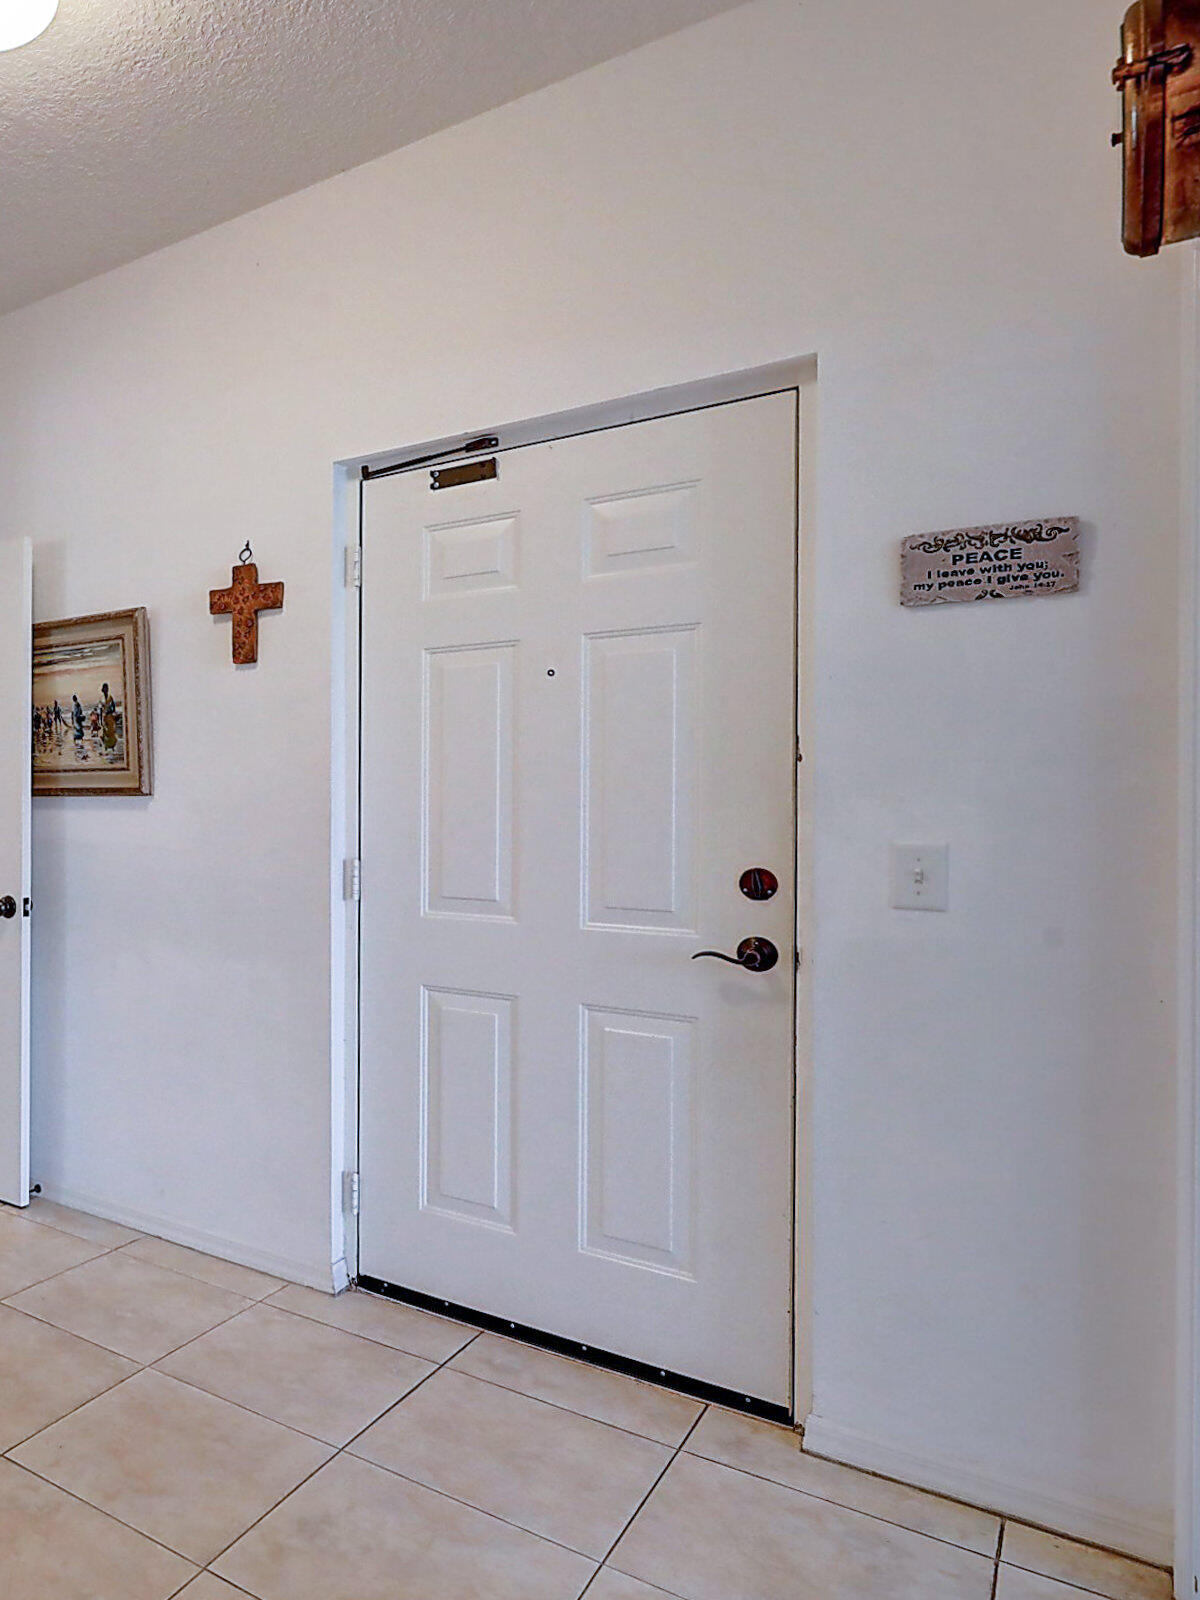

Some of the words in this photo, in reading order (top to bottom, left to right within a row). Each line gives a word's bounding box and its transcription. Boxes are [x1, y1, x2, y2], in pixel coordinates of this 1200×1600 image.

[952, 548, 1023, 565] PEACE
[927, 570, 932, 579] I
[937, 567, 975, 578] leave
[979, 562, 1013, 574] with
[913, 581, 934, 592] my
[938, 577, 982, 590] peace
[987, 575, 992, 584] I
[997, 572, 1029, 585] give
[1033, 569, 1065, 582] you.
